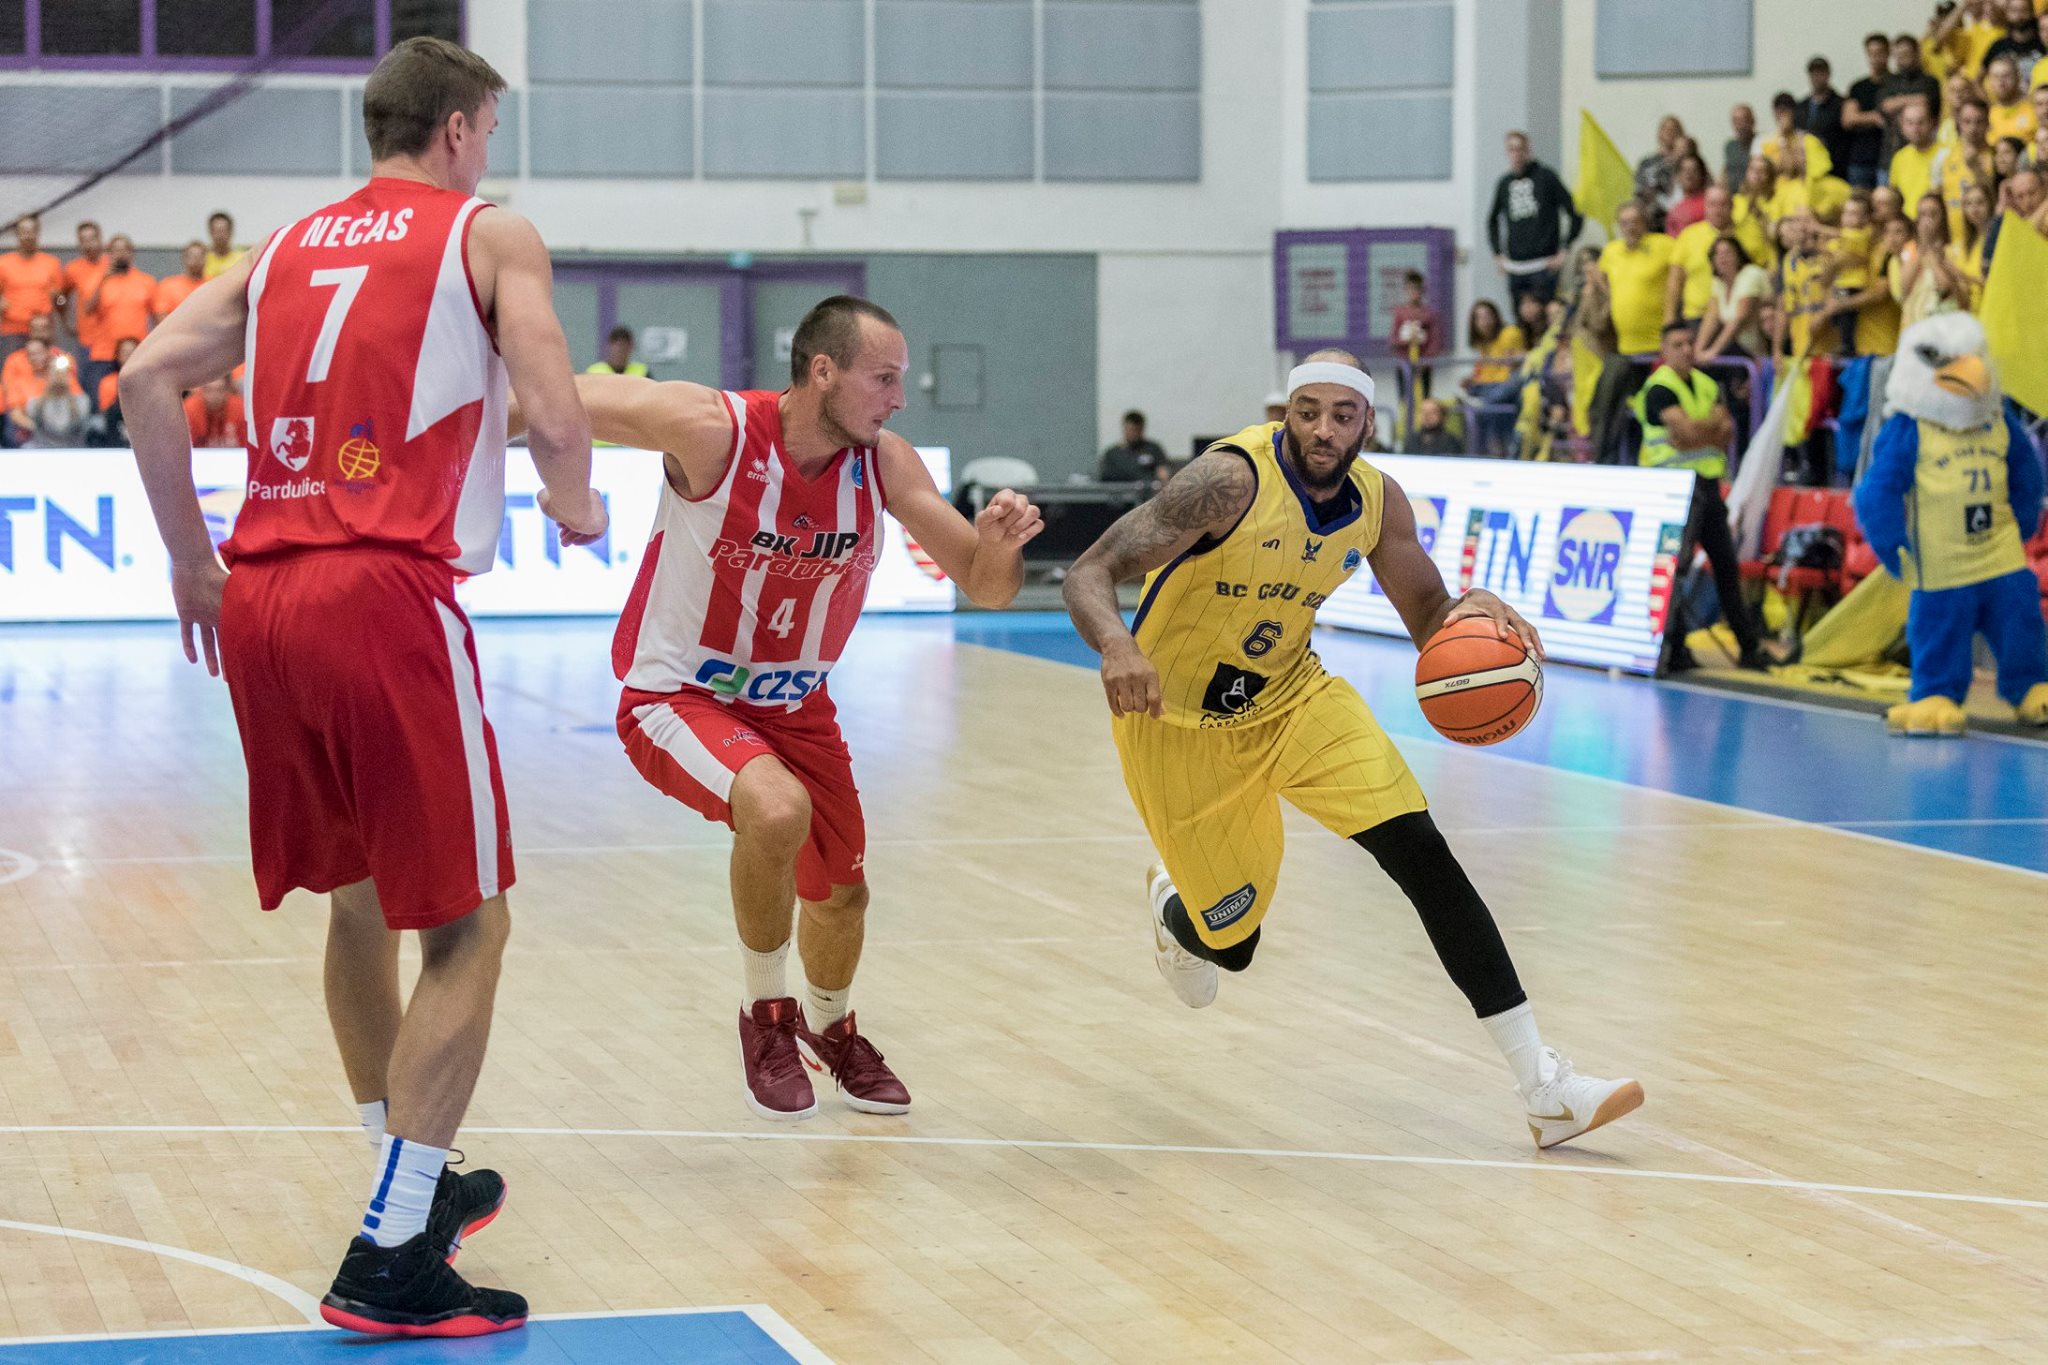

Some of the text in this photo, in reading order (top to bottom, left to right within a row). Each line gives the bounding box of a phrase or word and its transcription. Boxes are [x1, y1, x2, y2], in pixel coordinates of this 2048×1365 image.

[299, 207, 414, 247] NEČAS
[306, 264, 370, 383] 7
[1963, 468, 1991, 492] 71
[751, 530, 860, 559] BK JIP
[1554, 537, 1622, 591] SNR
[1215, 580, 1248, 597] BC
[1257, 582, 1301, 600] CSU
[767, 598, 798, 639] 4
[1242, 620, 1284, 659] 6
[1209, 887, 1250, 921] UNIMAT
